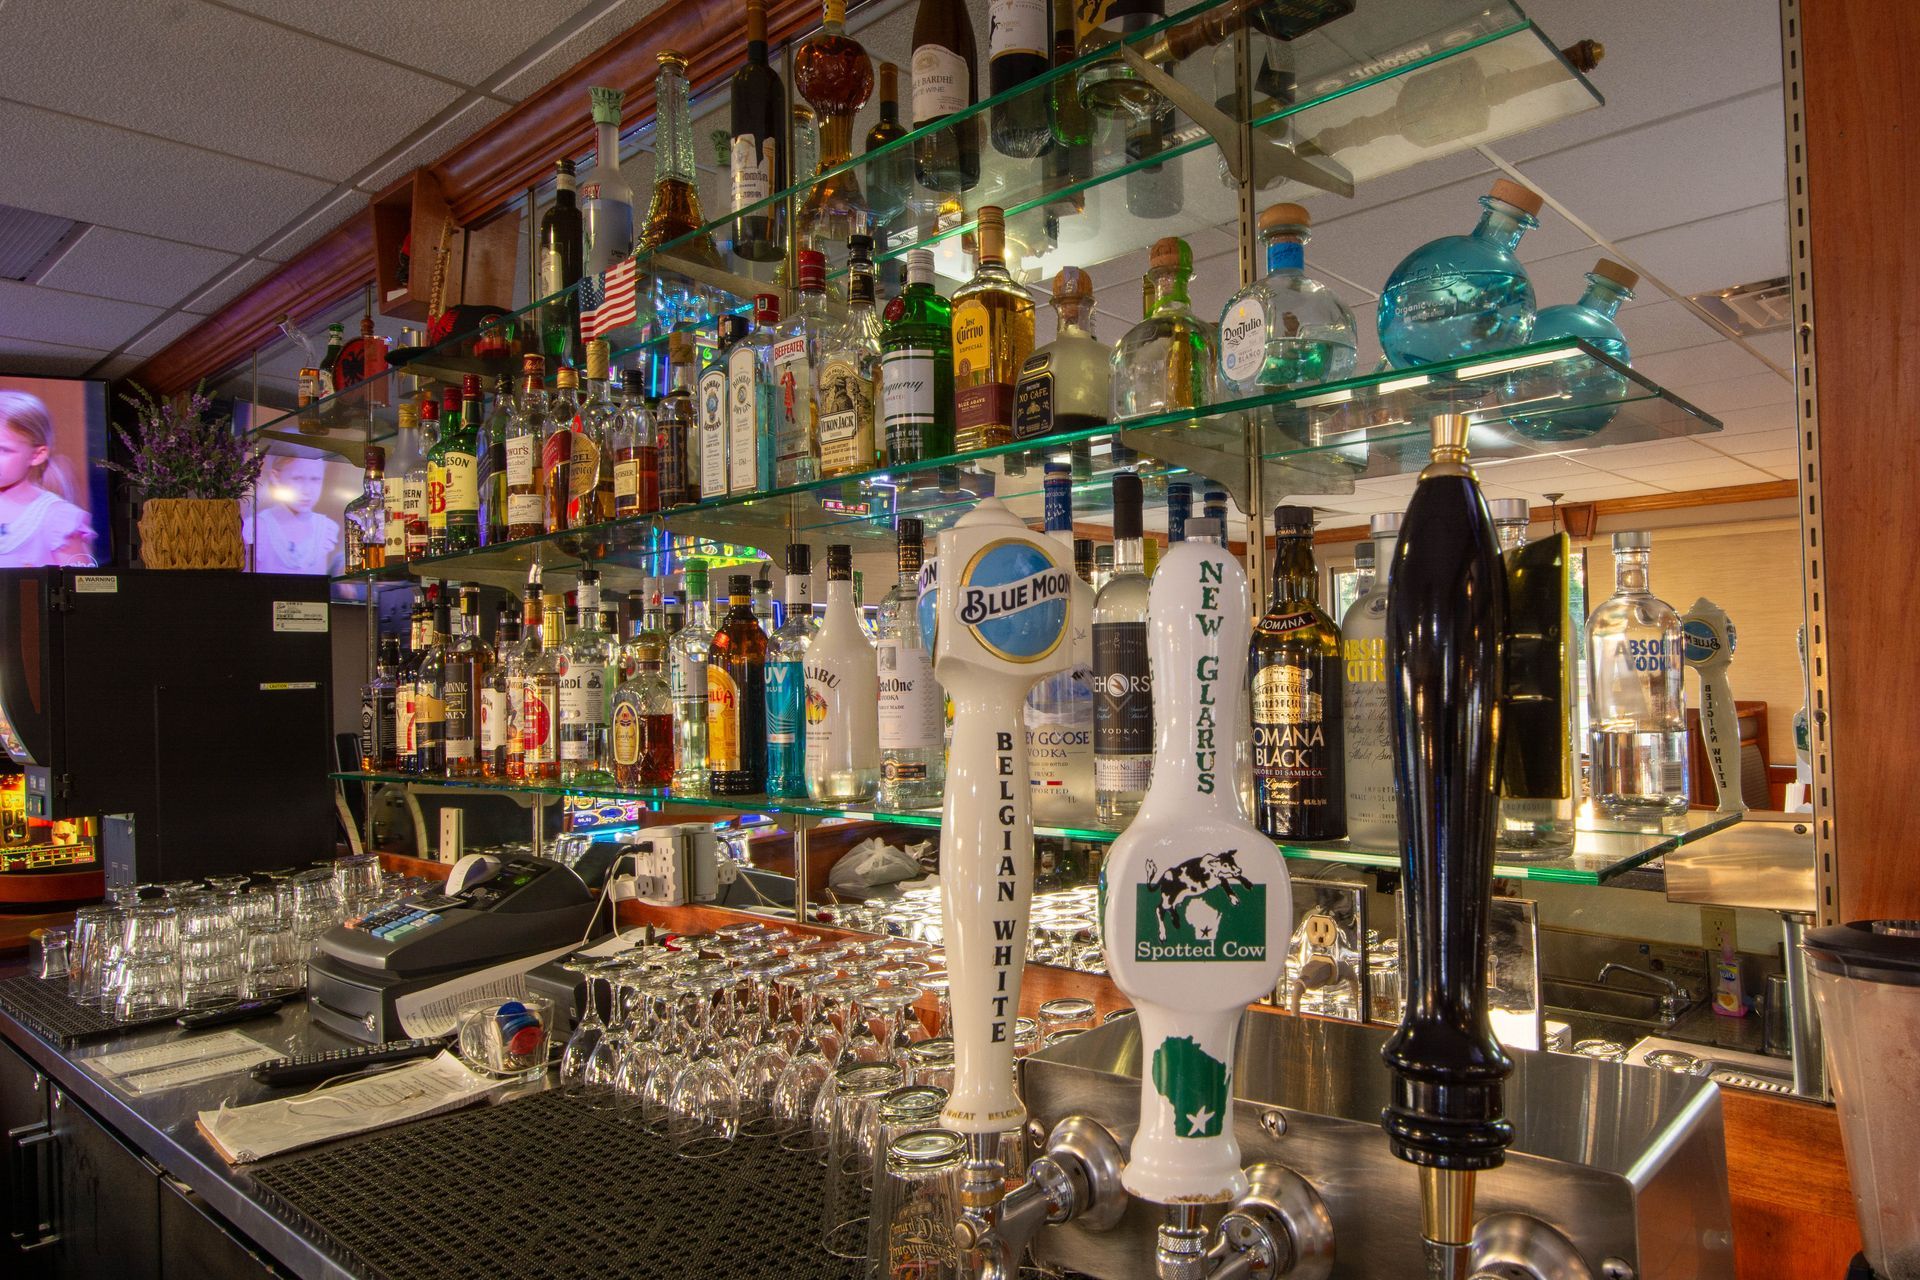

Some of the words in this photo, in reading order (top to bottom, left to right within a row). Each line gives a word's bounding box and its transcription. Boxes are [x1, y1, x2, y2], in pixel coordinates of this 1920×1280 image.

[957, 325, 984, 345] Cuervo
[775, 339, 805, 361] BEEFEATER
[959, 343, 983, 353] ESPECIAL
[1239, 349, 1261, 363] BLANCO
[704, 379, 721, 394] BOMBAY
[732, 375, 751, 390] BOMBAY
[958, 401, 969, 409] BLUE
[1019, 394, 1028, 403] XO
[838, 415, 854, 430] JACK
[446, 457, 470, 468] ESON
[403, 490, 422, 499] HERN
[403, 500, 419, 510] FORT
[960, 584, 1028, 624] BLUE
[1196, 560, 1224, 637] NEW
[1261, 616, 1306, 630] ROMANA
[1344, 638, 1385, 661] ABSO
[764, 667, 787, 684] UV
[1347, 660, 1386, 682] CITR
[560, 676, 581, 689] ARDÍ
[1094, 673, 1150, 697] EHORS
[1197, 656, 1219, 794] GLARUS
[1025, 732, 1035, 745] EY
[1038, 731, 1089, 745] GOOSE
[1027, 748, 1067, 758] VODKA
[1256, 747, 1309, 768] BLACK
[997, 732, 1016, 902] BELGIAN
[1137, 940, 1215, 960] Spotted
[1223, 942, 1265, 957] Cow
[992, 921, 1016, 1042] WHITE
[946, 1108, 976, 1120] WHEAT
